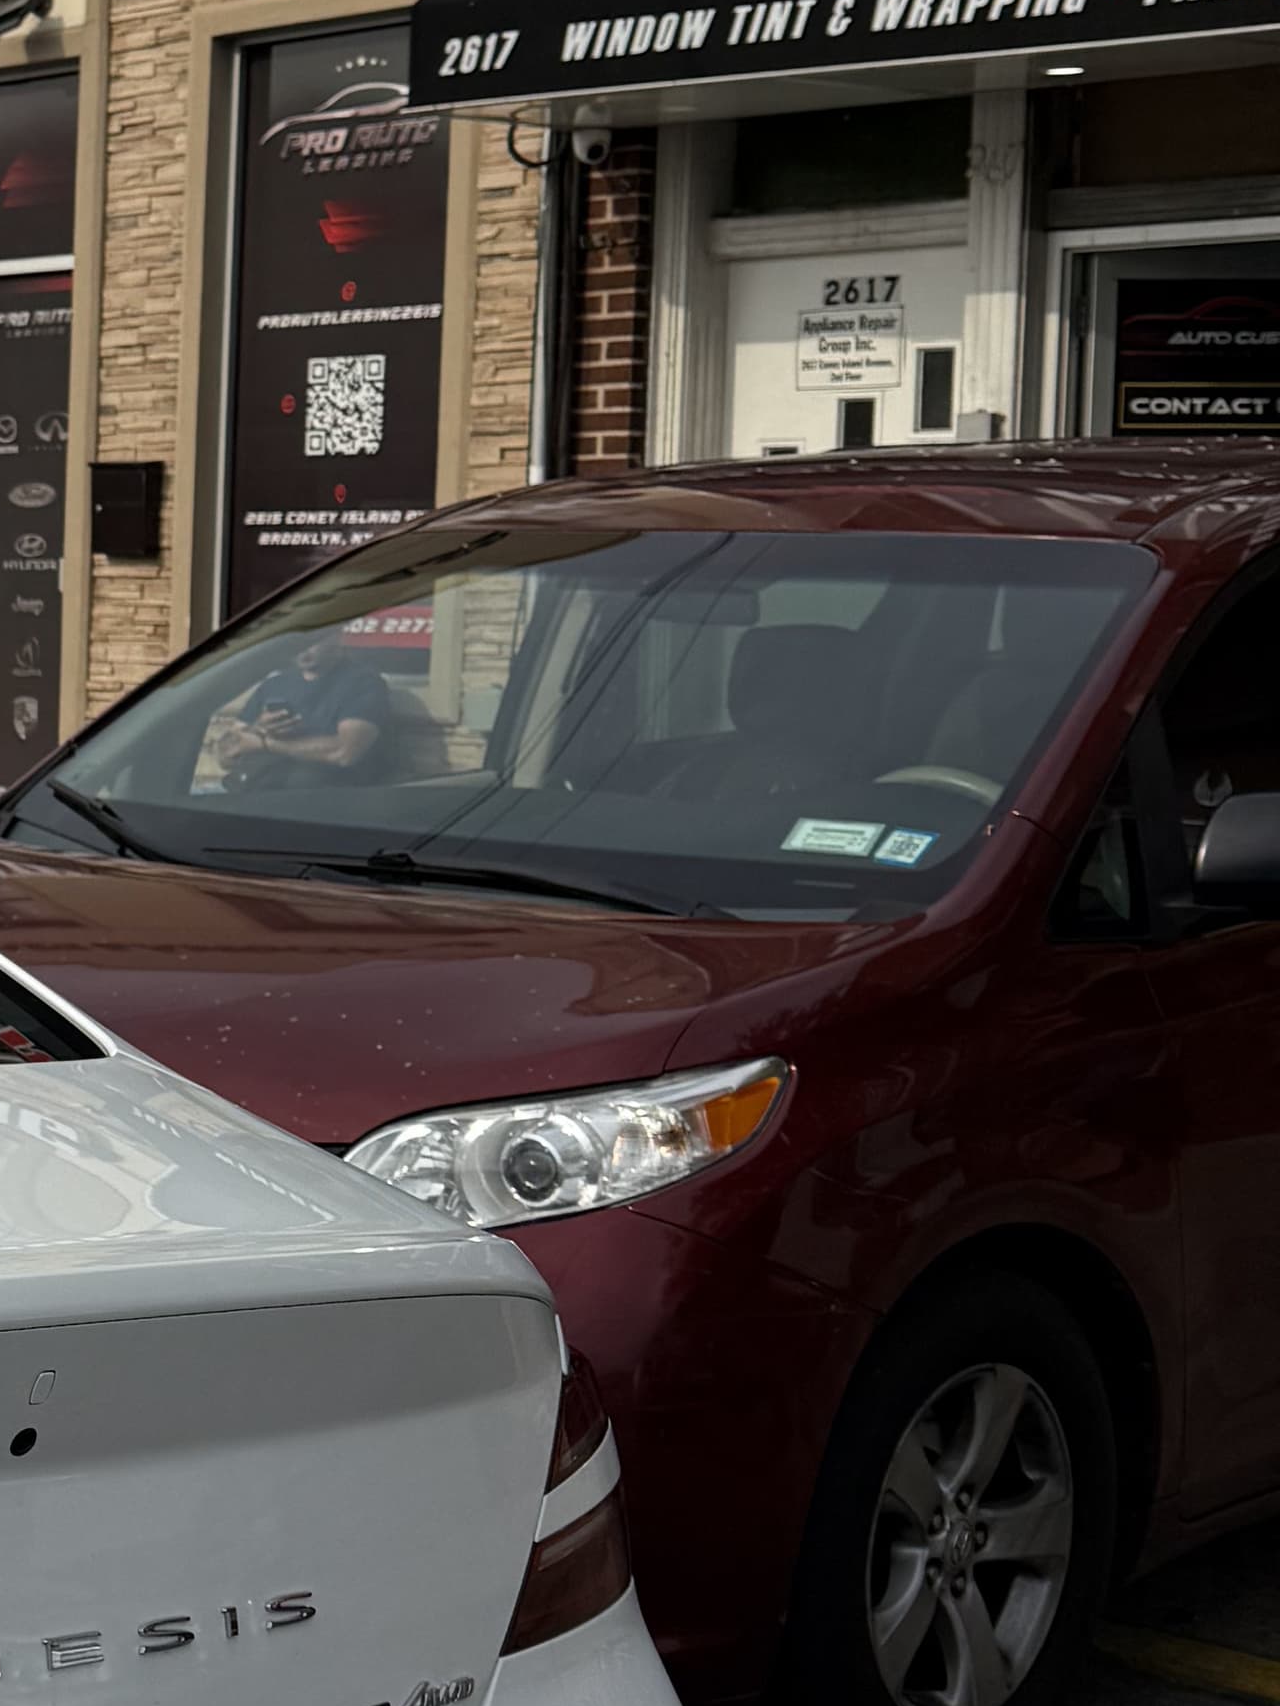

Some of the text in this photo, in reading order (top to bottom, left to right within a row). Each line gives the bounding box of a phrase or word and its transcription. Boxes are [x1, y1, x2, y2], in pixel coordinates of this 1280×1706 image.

[439, 31, 520, 77] 2617
[561, 6, 717, 64] WINDOW
[280, 115, 440, 159] PRO AUTO
[303, 149, 414, 175] LEASING
[824, 275, 900, 306] 2617
[803, 314, 897, 334] Appliance Repair
[819, 336, 851, 353] Group
[1167, 331, 1232, 345] AUTO
[1129, 397, 1270, 415] CONTACT
[244, 511, 283, 525] 2615
[285, 510, 339, 525] CONEY
[341, 509, 402, 525] ISLAND
[258, 531, 347, 547] BROOKLYN,
